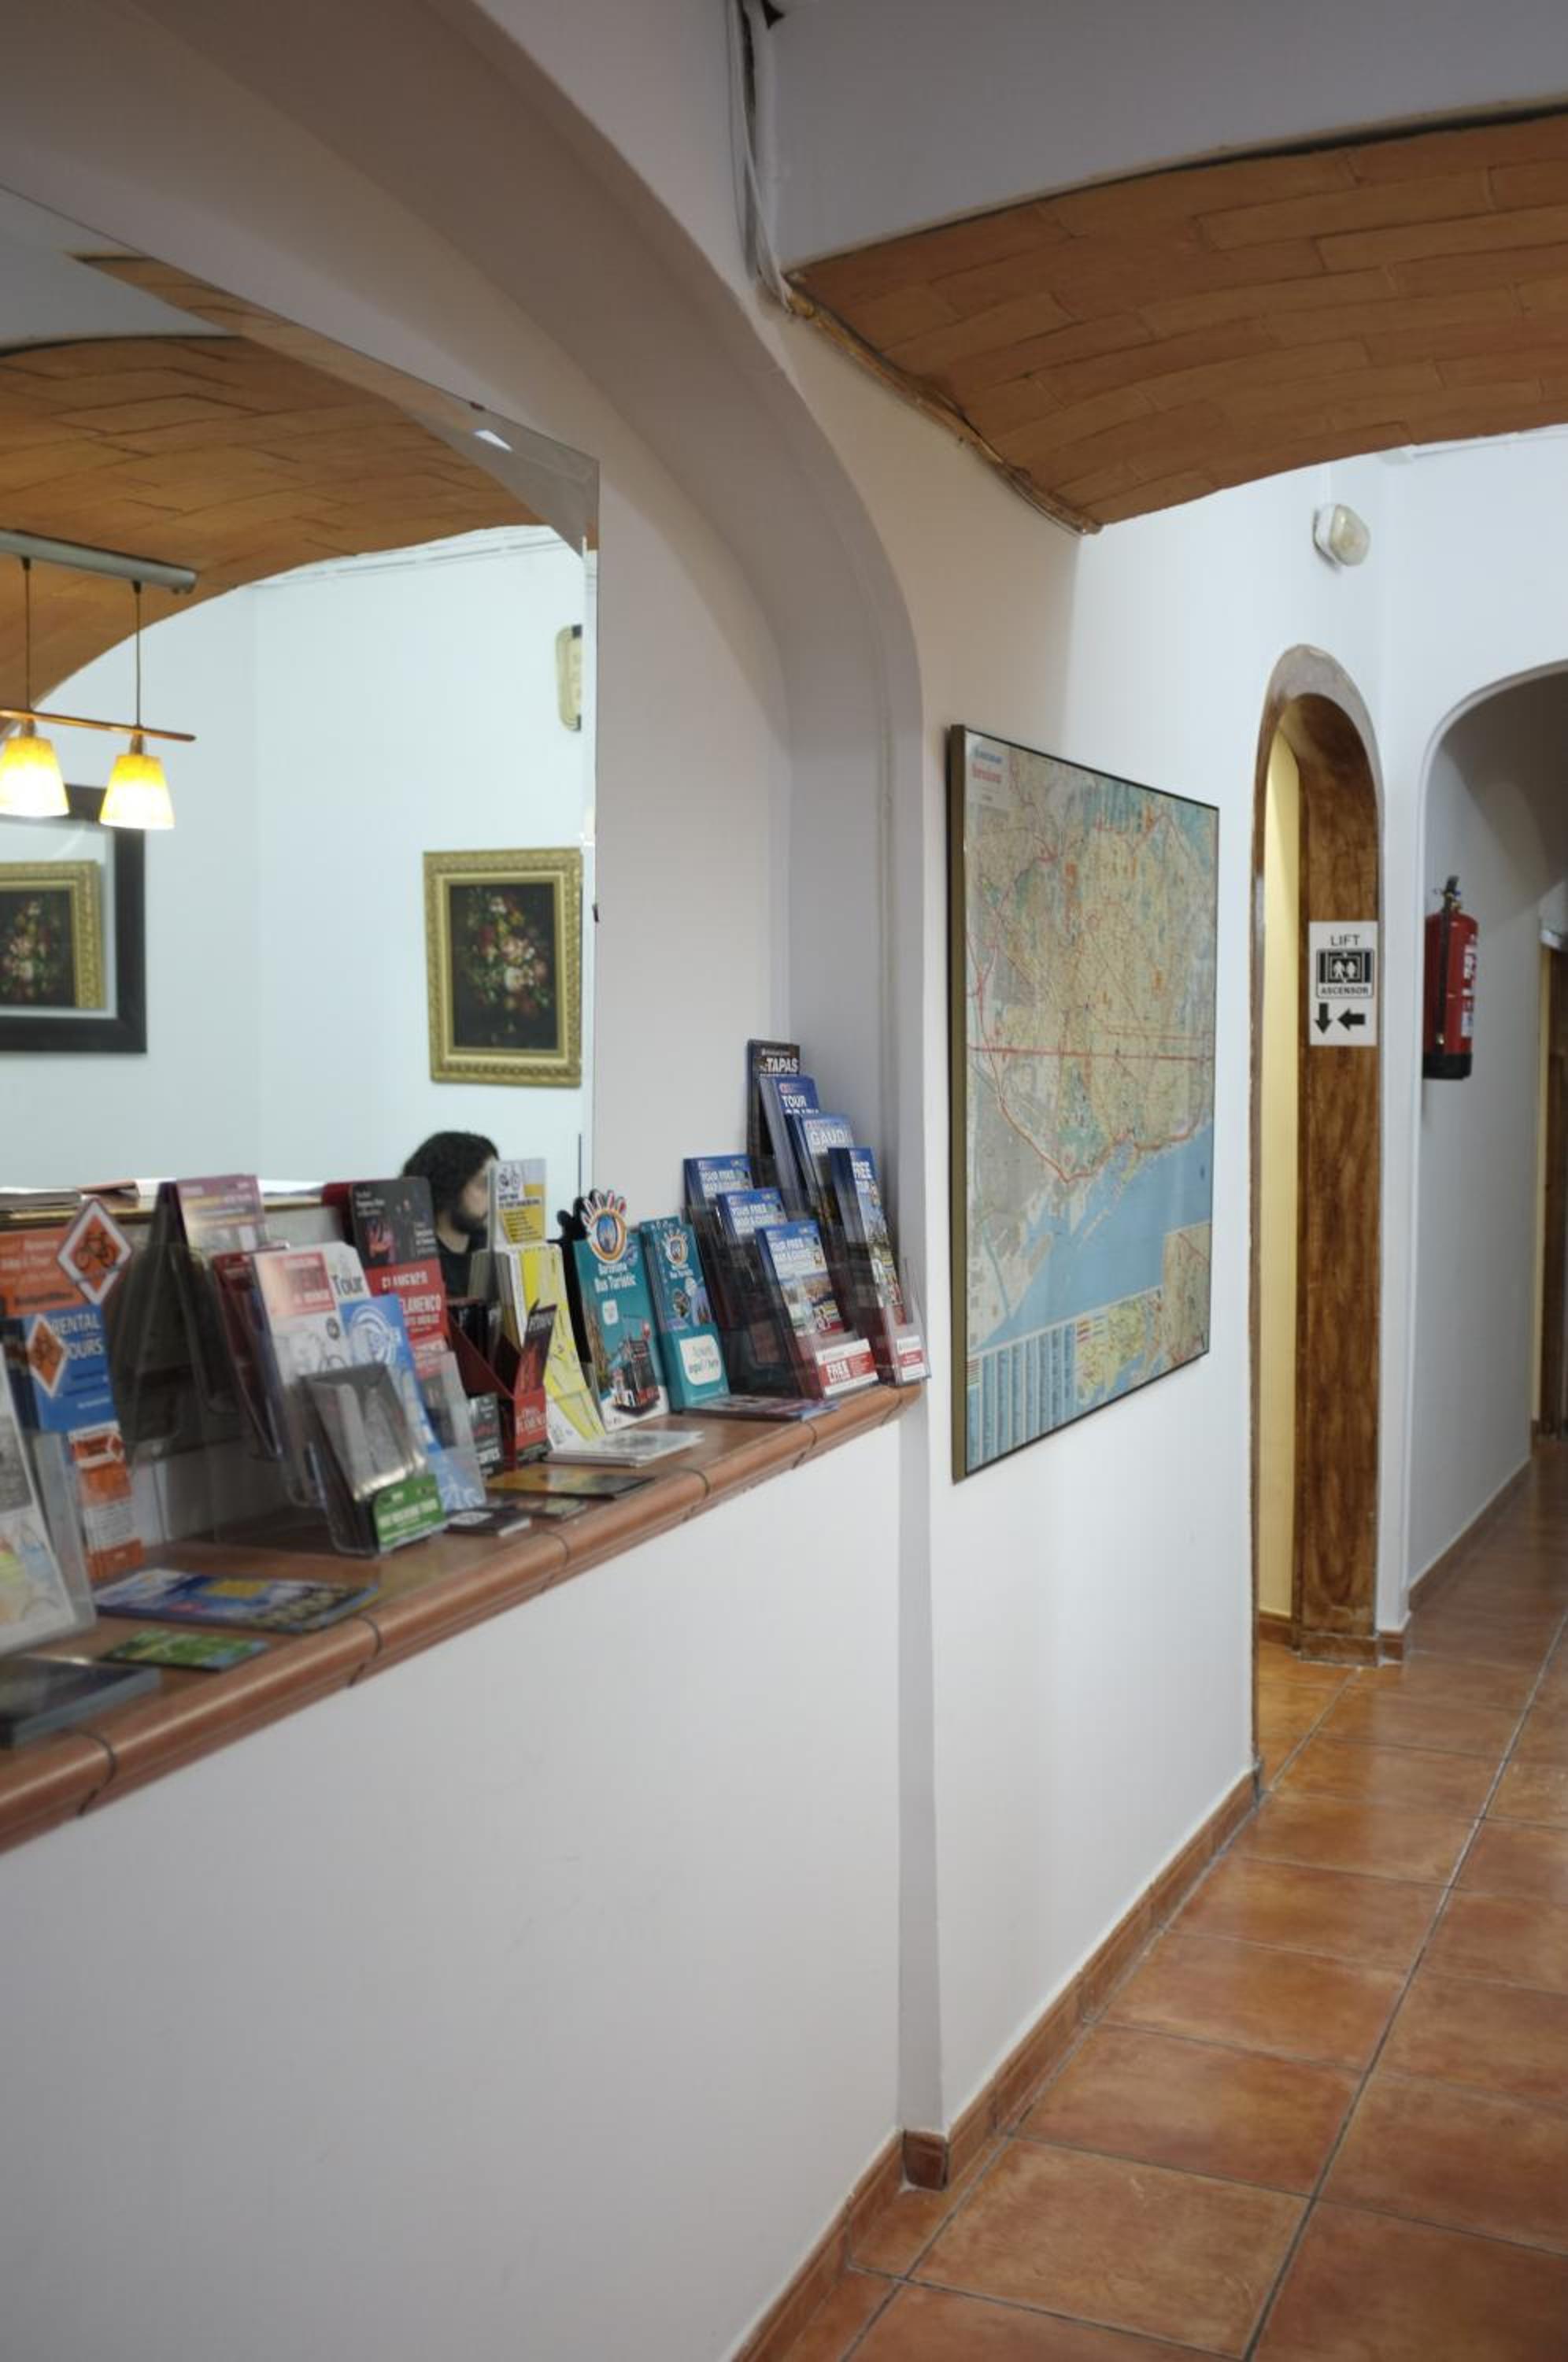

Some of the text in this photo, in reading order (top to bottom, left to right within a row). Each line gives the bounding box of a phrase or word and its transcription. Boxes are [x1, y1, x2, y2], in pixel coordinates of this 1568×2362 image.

[1329, 934, 1360, 946] LIFT
[1321, 986, 1369, 995] ASCENSOR
[767, 1057, 798, 1073] TAPAS
[782, 1094, 808, 1109] TOUR
